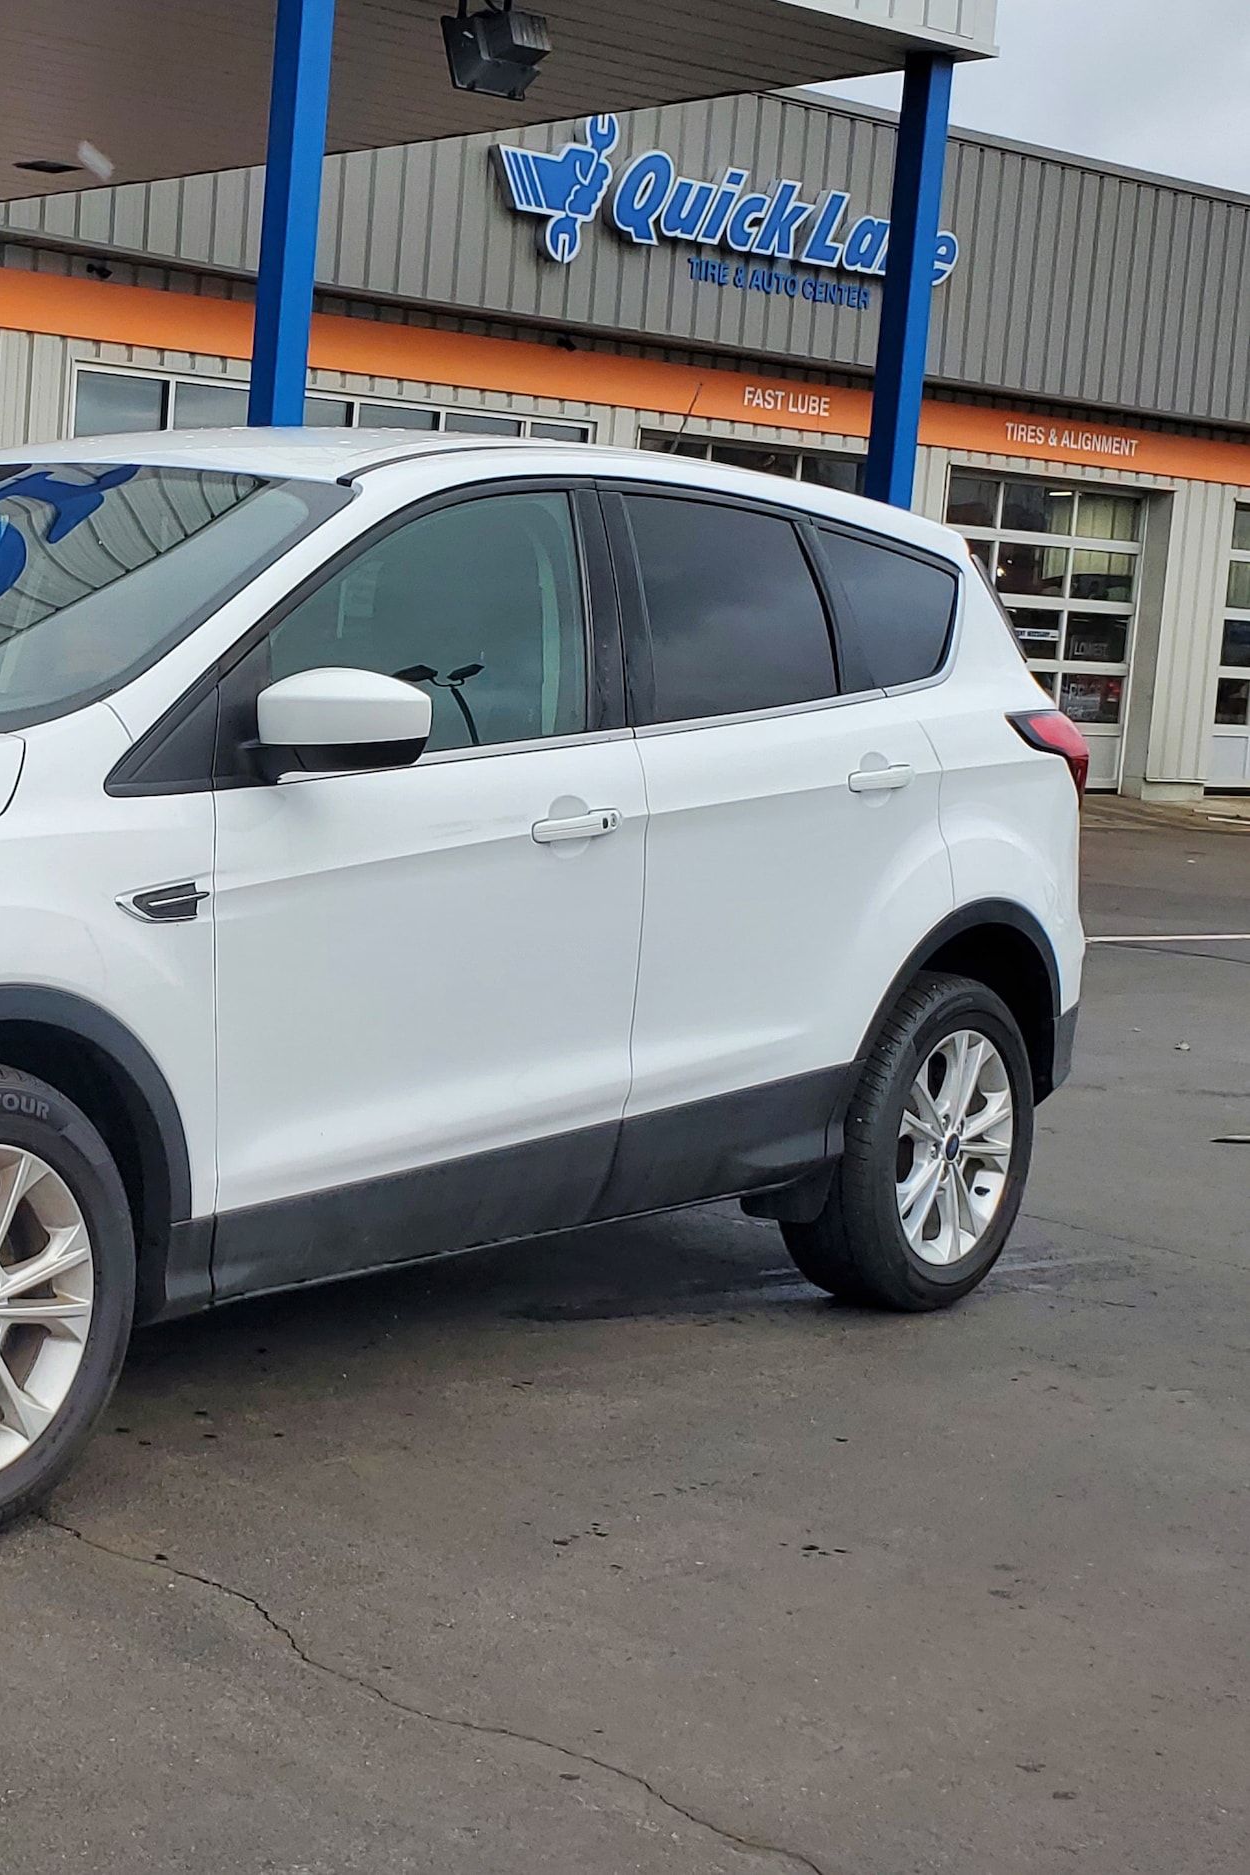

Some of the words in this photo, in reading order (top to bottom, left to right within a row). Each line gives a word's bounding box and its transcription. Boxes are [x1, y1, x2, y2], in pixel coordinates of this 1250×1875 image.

[612, 150, 815, 259] Quick
[801, 190, 959, 286] Lae
[688, 257, 729, 286] TIRE
[734, 266, 746, 289] &
[750, 269, 800, 298] AUTO
[802, 277, 871, 310] CENTER
[743, 386, 785, 411] FAST
[788, 392, 831, 417] LUBE
[1006, 422, 1046, 445] TIRES
[1048, 428, 1058, 447] &
[1060, 430, 1139, 457] ALIGNMENT
